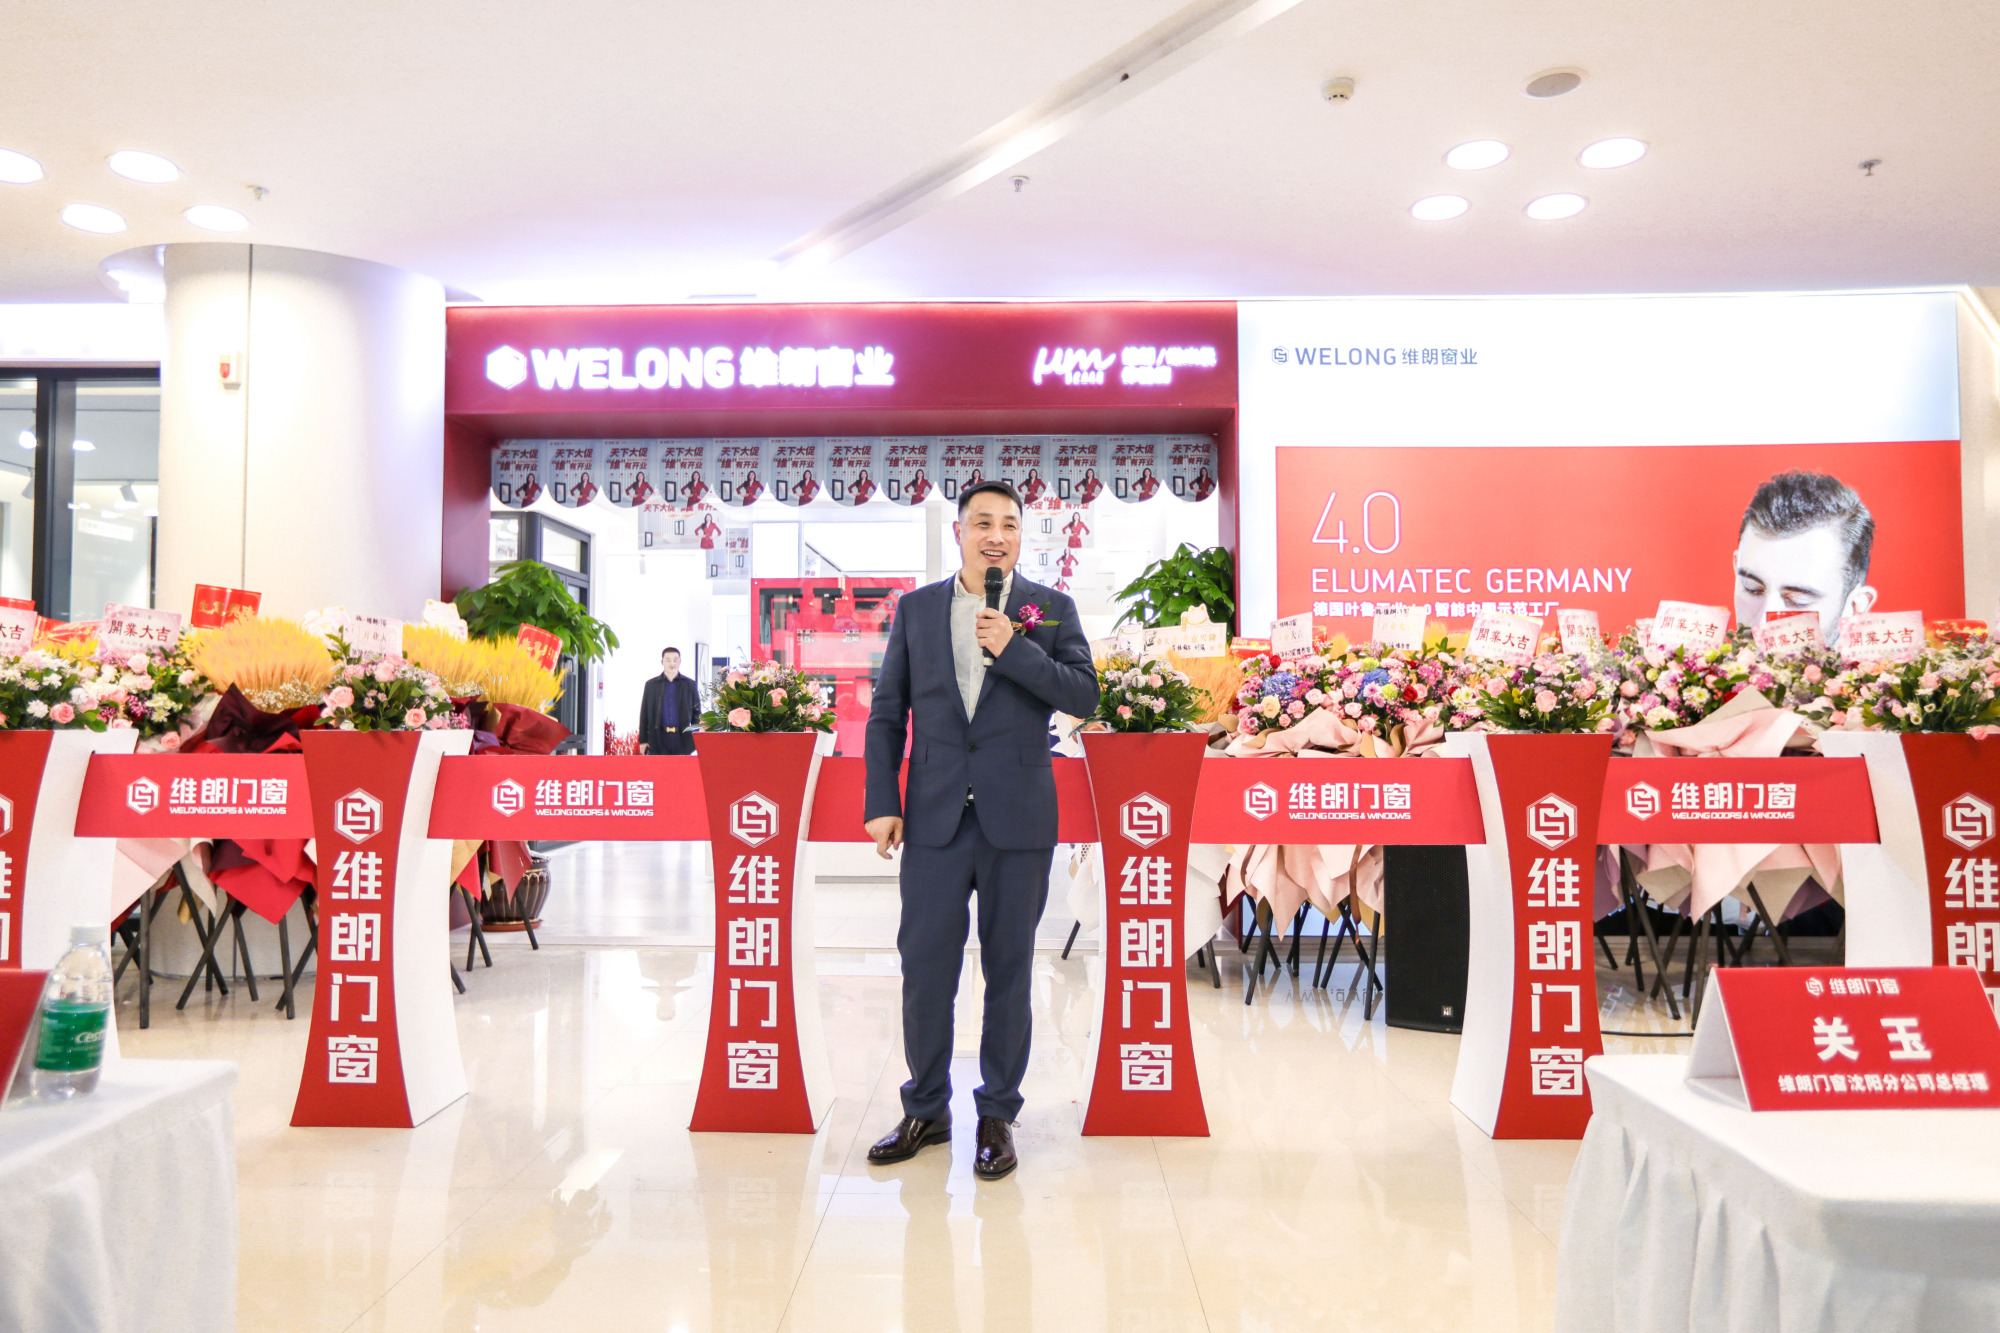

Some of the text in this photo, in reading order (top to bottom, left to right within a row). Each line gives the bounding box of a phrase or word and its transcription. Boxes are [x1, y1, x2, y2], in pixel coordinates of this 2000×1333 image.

[1295, 347, 1397, 365] WELONG
[1402, 347, 1478, 365] 维朗窗业
[531, 346, 735, 389] WELONG
[499, 449, 539, 459] 天下大促
[554, 448, 594, 458] 天下大促
[609, 447, 648, 457] 天下大促
[664, 447, 704, 457] 天下大促
[720, 446, 760, 456] 天下大促
[776, 446, 816, 456] 天下大促
[832, 445, 872, 456] 天下大促
[888, 445, 928, 455] 天下大促
[944, 445, 985, 455] 天下大促
[1001, 445, 1041, 455] 天下大促
[1058, 445, 1098, 455] 天下大促
[1115, 444, 1155, 454] 天下大促
[1171, 444, 1211, 454] 天下大促
[1311, 490, 1400, 554] 4.0
[1312, 567, 1632, 594] ELUMATEC GERMANY
[108, 619, 171, 642] 開業大吉
[1660, 616, 1719, 638] 開業大吉
[1476, 627, 1530, 650] 開業大吉
[1763, 627, 1816, 652] 開業大吉
[1849, 627, 1915, 649] 開業大吉
[169, 777, 288, 804] 维朗门窗
[535, 779, 654, 806] 维朗门窗
[1288, 782, 1411, 809] 维朗门窗
[1671, 782, 1797, 809] 维朗门窗
[169, 806, 206, 815] WELONG
[207, 807, 237, 815] DOORS
[244, 807, 287, 815] WINDOWS
[535, 808, 573, 816] WELONG
[573, 808, 604, 816] DOORS
[611, 809, 654, 817] WINDOWS
[1288, 812, 1327, 820] WELONG
[1327, 812, 1359, 820] DOORS
[1367, 812, 1411, 820] WINDOWS
[1671, 812, 1710, 820] WELONG
[1710, 812, 1742, 820] DOORS
[1749, 812, 1795, 820] WINDOWS
[328, 851, 383, 1084] 维朗门窗
[727, 855, 780, 1090] 维朗门窗
[1119, 856, 1173, 1091] 维朗门窗
[1527, 857, 1584, 1096] 维朗门窗
[1829, 977, 1900, 995] 维朗门窗
[1778, 1073, 1990, 1094] 维朗门窗沈阳分公司总经理
